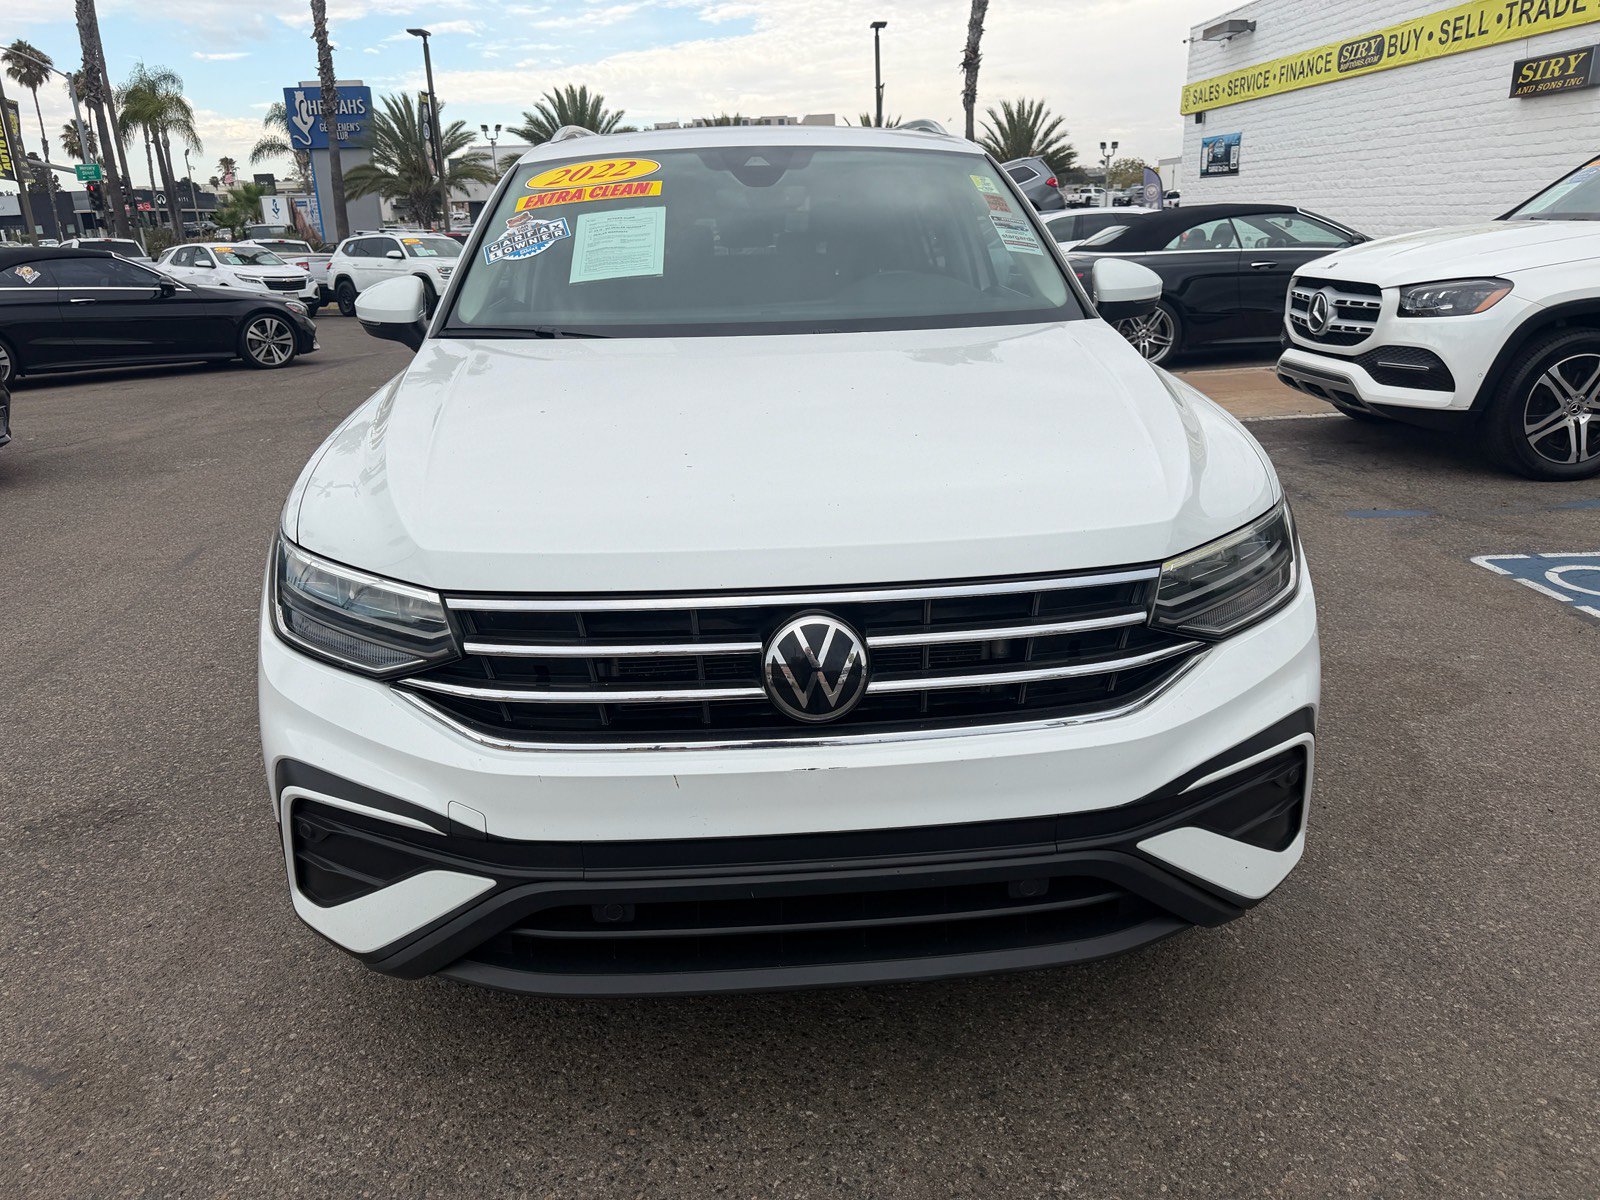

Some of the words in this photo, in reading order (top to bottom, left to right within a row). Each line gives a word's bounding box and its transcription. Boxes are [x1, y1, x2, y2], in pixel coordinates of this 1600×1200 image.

[1387, 26, 1424, 58] BUY
[1438, 10, 1489, 45] SELL
[1340, 37, 1383, 63] SIRY
[1193, 84, 1220, 105] SALES
[1227, 70, 1271, 97] SERVICE
[1278, 51, 1333, 84] FINANCE
[1518, 52, 1588, 84] SIRY
[1515, 85, 1536, 95] AND
[1536, 80, 1564, 92] SONS
[1564, 77, 1584, 87] INC
[544, 161, 637, 187] 2022
[523, 189, 587, 209] EXTRA
[589, 182, 654, 199] CLEAN
[490, 224, 561, 252] CARFAX
[503, 230, 564, 255] OWNER
